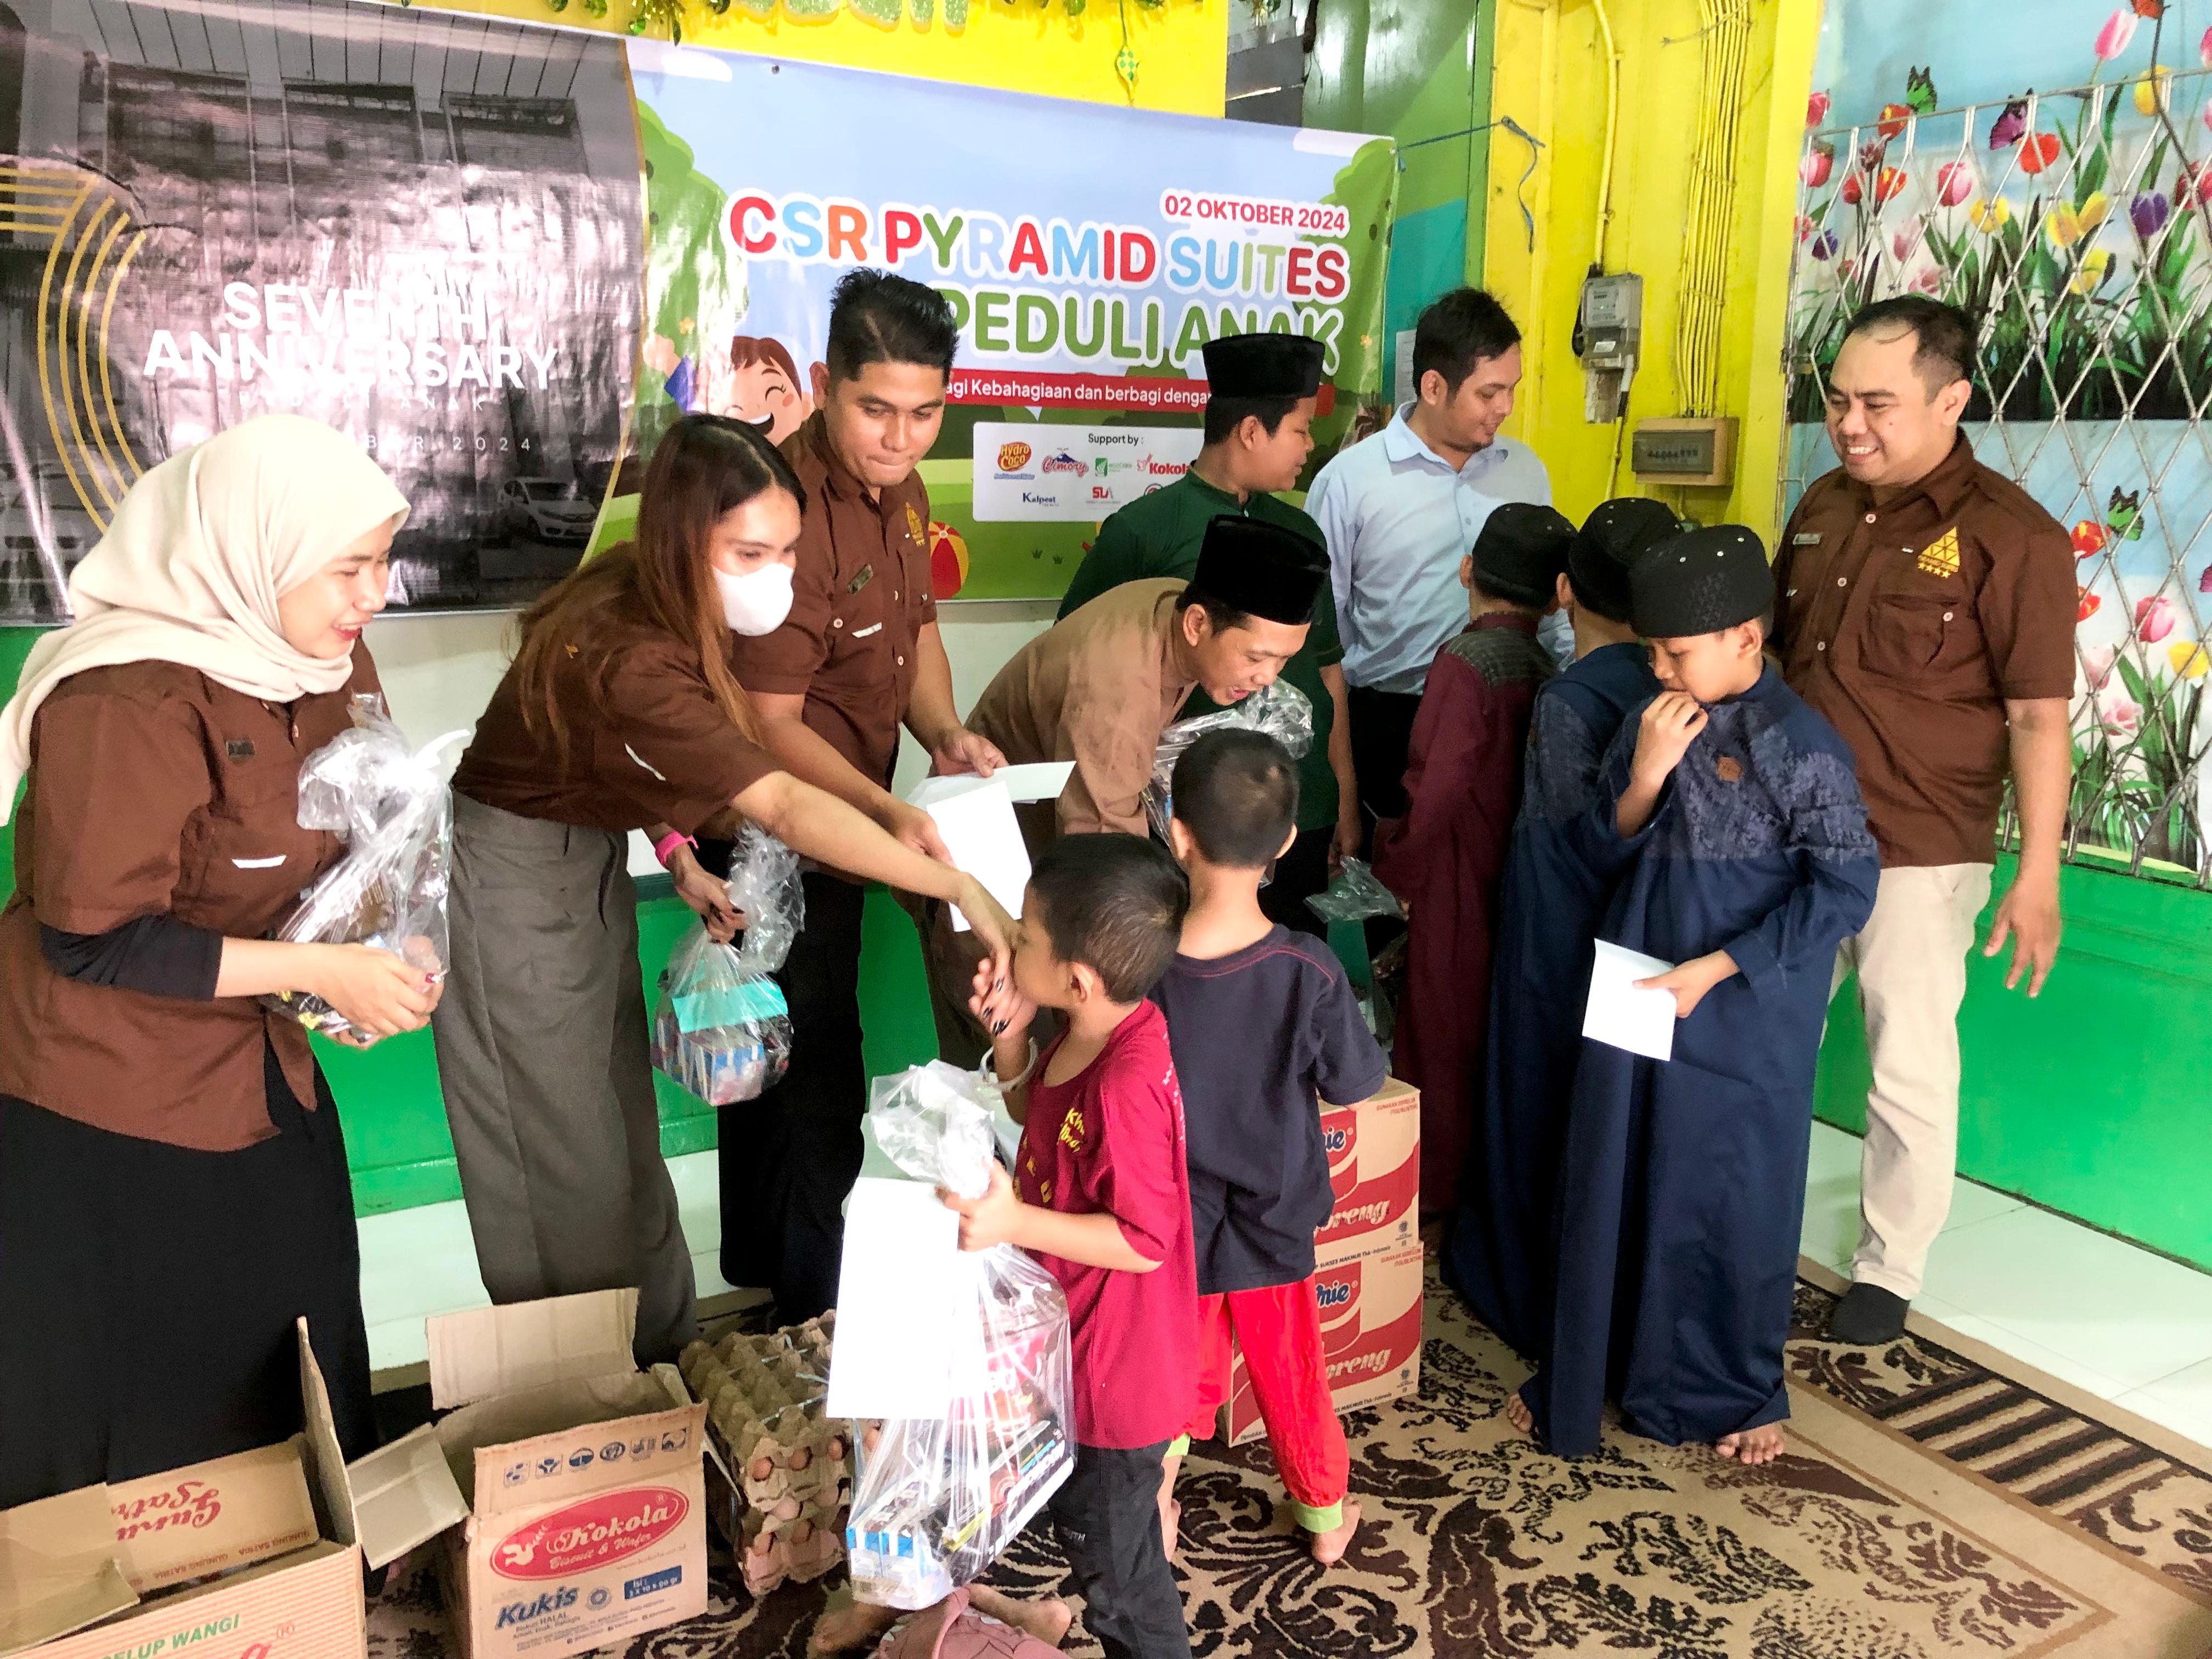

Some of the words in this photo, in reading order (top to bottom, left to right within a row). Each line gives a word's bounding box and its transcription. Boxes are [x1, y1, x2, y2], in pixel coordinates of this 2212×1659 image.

[1165, 195, 1192, 216] 02
[1197, 199, 1294, 227] OKTOBER
[1298, 208, 1345, 232] 2024
[730, 196, 867, 261] CSR
[885, 211, 1156, 283] PYRAMID
[1170, 236, 1346, 298] SUITES
[223, 281, 488, 340] SEVENTH
[143, 330, 558, 391] ANNIVERSARY
[946, 378, 968, 398] agi
[972, 378, 1071, 401] Kebahagiaan
[1074, 384, 1102, 400] dan
[1105, 386, 1161, 405] berbagi
[453, 437, 531, 452] 2024
[1000, 443, 1030, 456] Hydro
[1088, 433, 1126, 444] Support
[1128, 434, 1139, 445] by
[1041, 455, 1087, 477] Cimory
[1149, 462, 1187, 475] Kokol
[1325, 1348, 1392, 1380] oreng
[546, 1497, 679, 1554] Kokola
[495, 1585, 580, 1630] Kukis
[172, 1614, 240, 1650] WANGI
